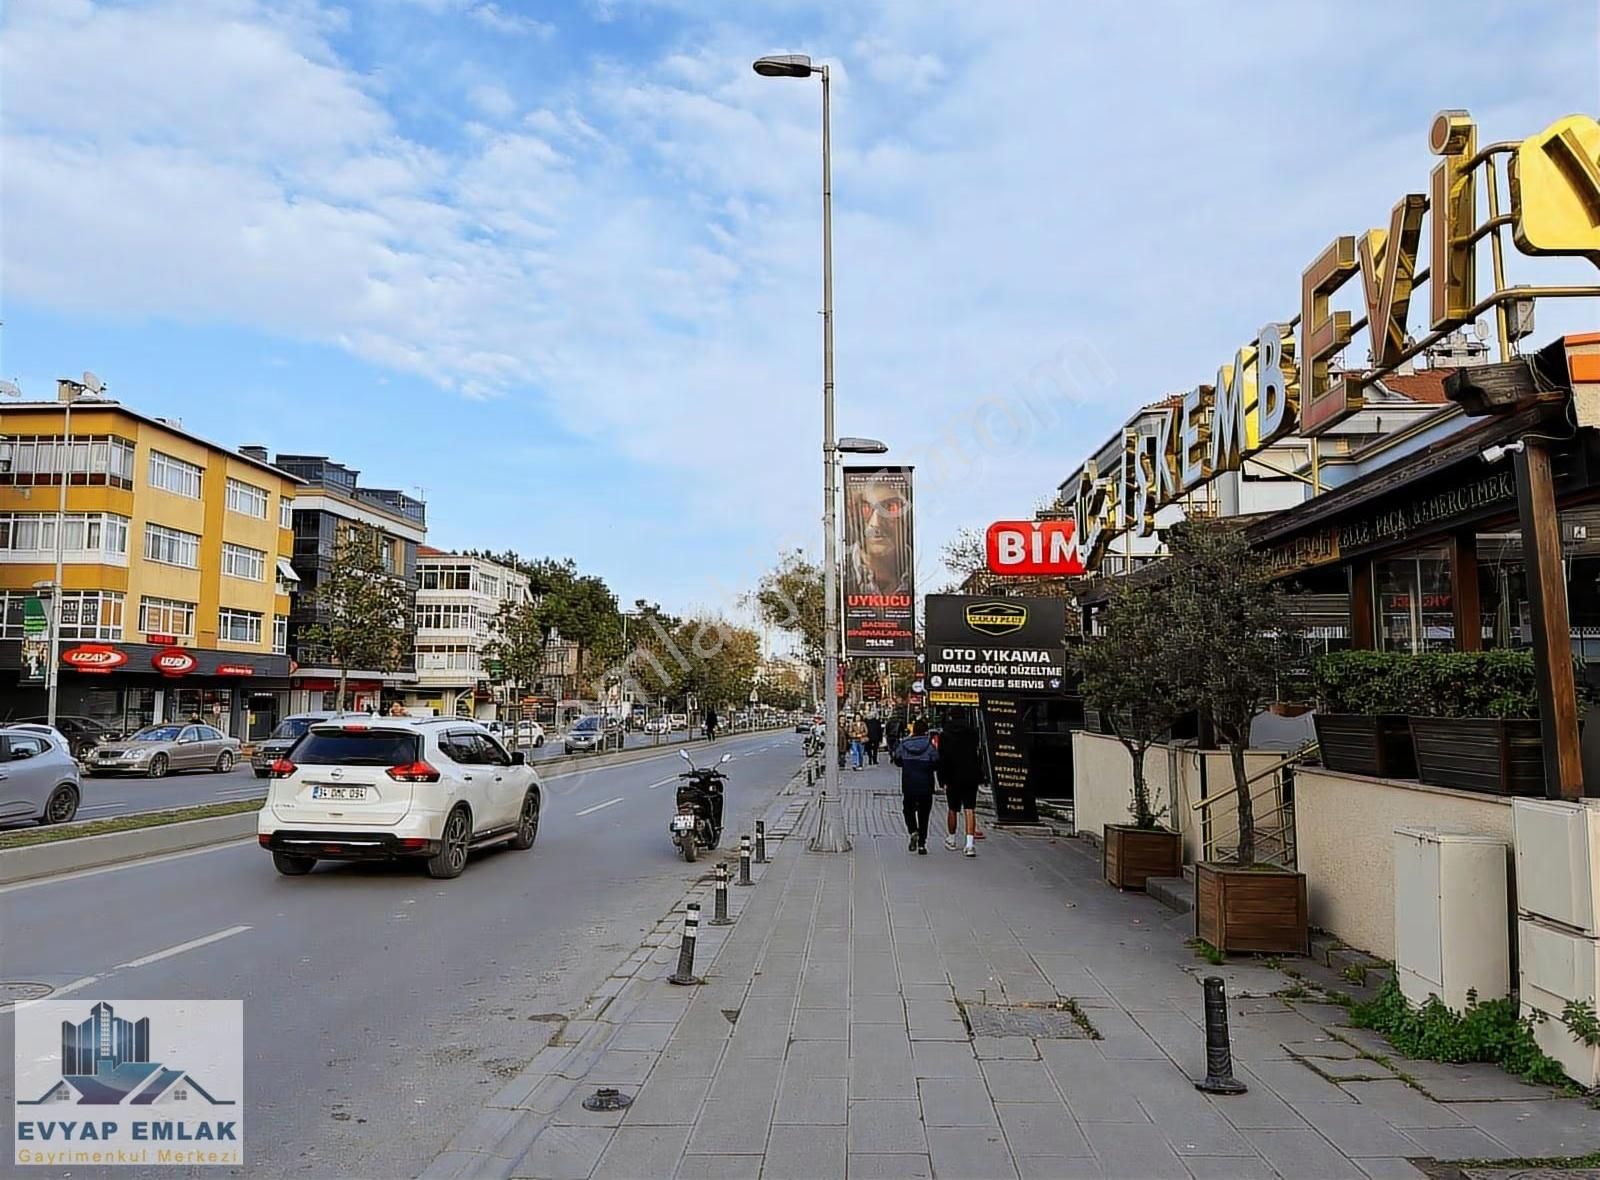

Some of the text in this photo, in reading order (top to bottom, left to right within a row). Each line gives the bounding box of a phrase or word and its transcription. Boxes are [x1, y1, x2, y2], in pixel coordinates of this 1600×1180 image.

[998, 521, 1083, 564] BİM
[848, 595, 911, 607] UYKUCU
[942, 648, 1050, 662] OTO YIKAMA
[931, 662, 1062, 676] BOYASIZ GÖÇÜK DÜZELTME
[947, 677, 1005, 688] MERCEDES
